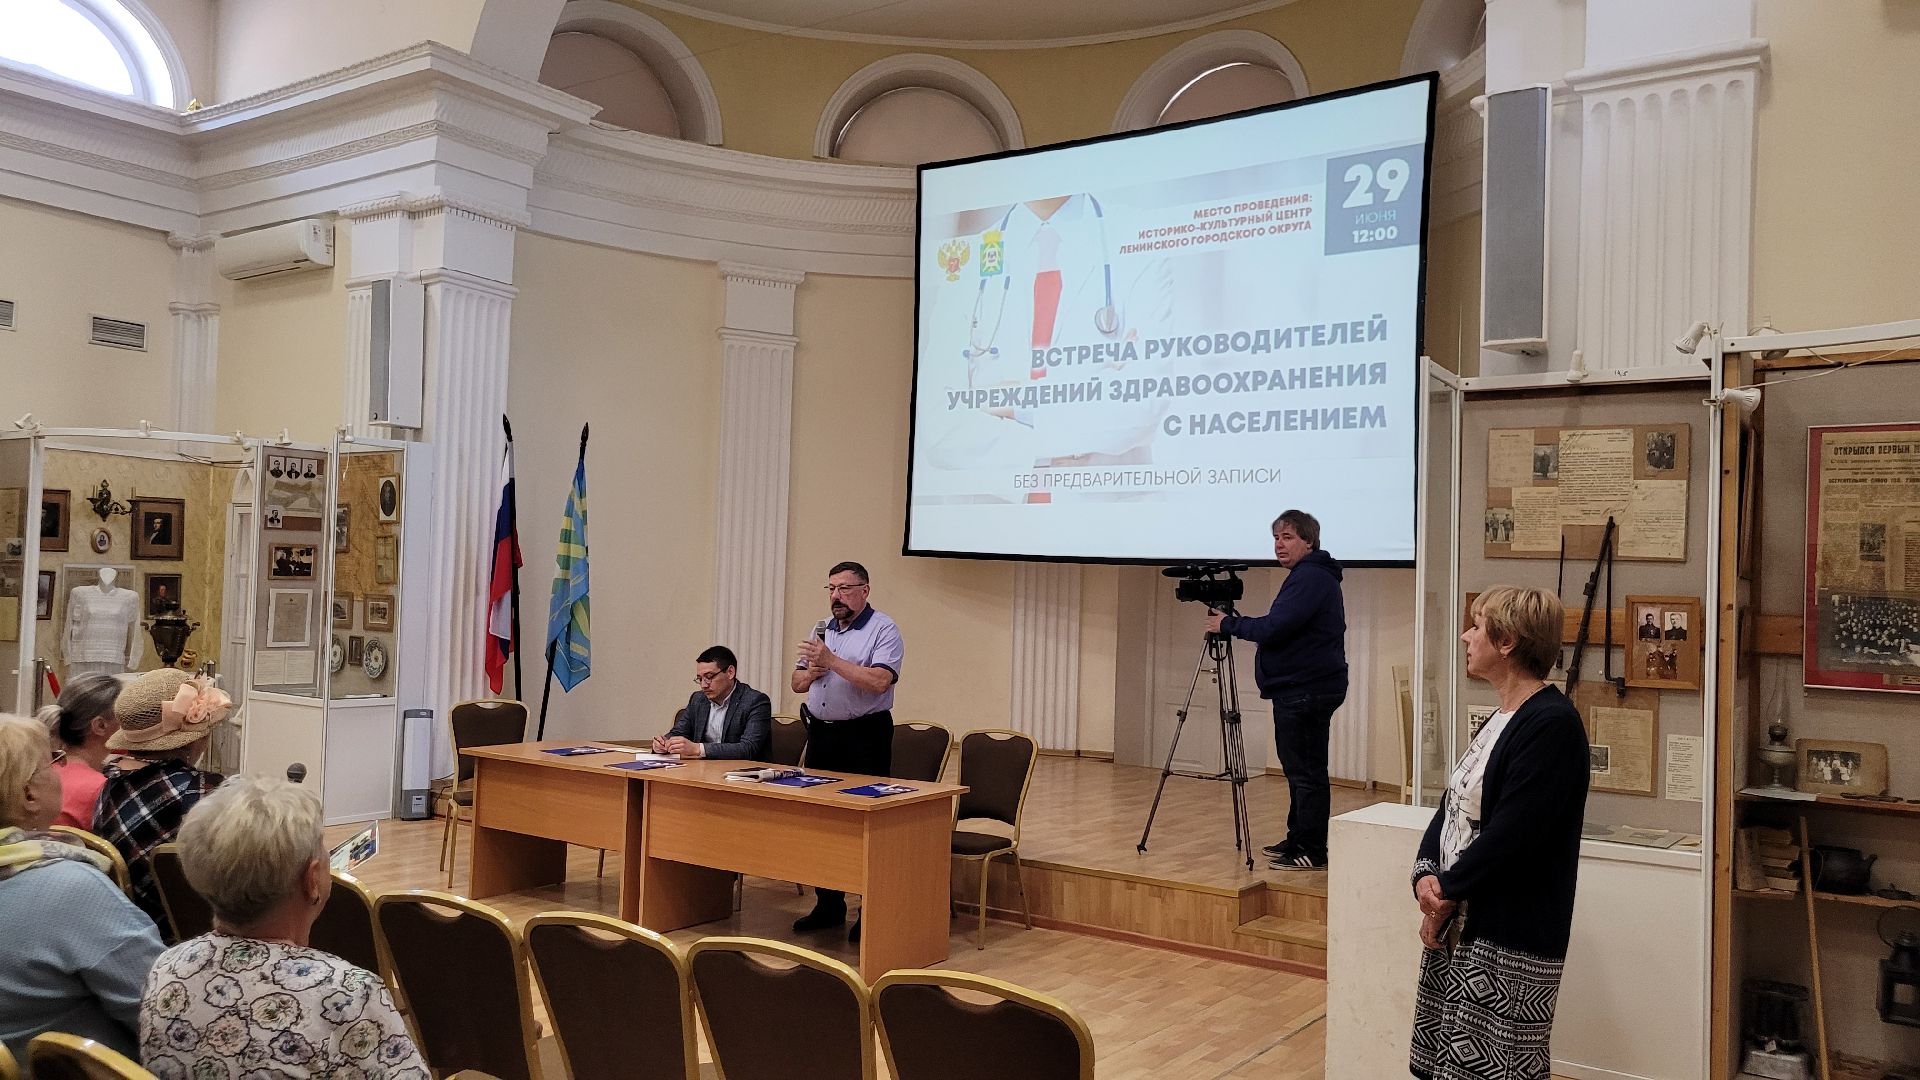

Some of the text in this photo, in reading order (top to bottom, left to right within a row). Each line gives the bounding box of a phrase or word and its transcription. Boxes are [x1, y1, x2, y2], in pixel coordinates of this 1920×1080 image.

[1342, 158, 1410, 209] 29
[1193, 193, 1312, 220] МЕСТО ПРОВЕДЕНИЯ:
[1355, 209, 1397, 225] ИЮНЯ
[1119, 220, 1312, 255] ЛЕНИНСКОГО ГОРОДСКОГО ОКРУГА
[1138, 207, 1312, 240] ИСТОРИКО-КУЛЬТУРНЫЙ ЦЕНТР
[1352, 225, 1399, 244] 12:00
[1031, 313, 1388, 369] ВСТРЕЧА РУКОВОДИТЕЛЕЙ
[947, 361, 1387, 411] УЧРЕЖДЕНИЙ ЗДРАВООХРАНЕНИЯ
[1163, 405, 1388, 437] С НАСЕЛЕНИЕМ
[1013, 467, 1282, 490] БЕЗ ПРЕДВАРИТЕЛЬНОЙ ЗАПИСИ
